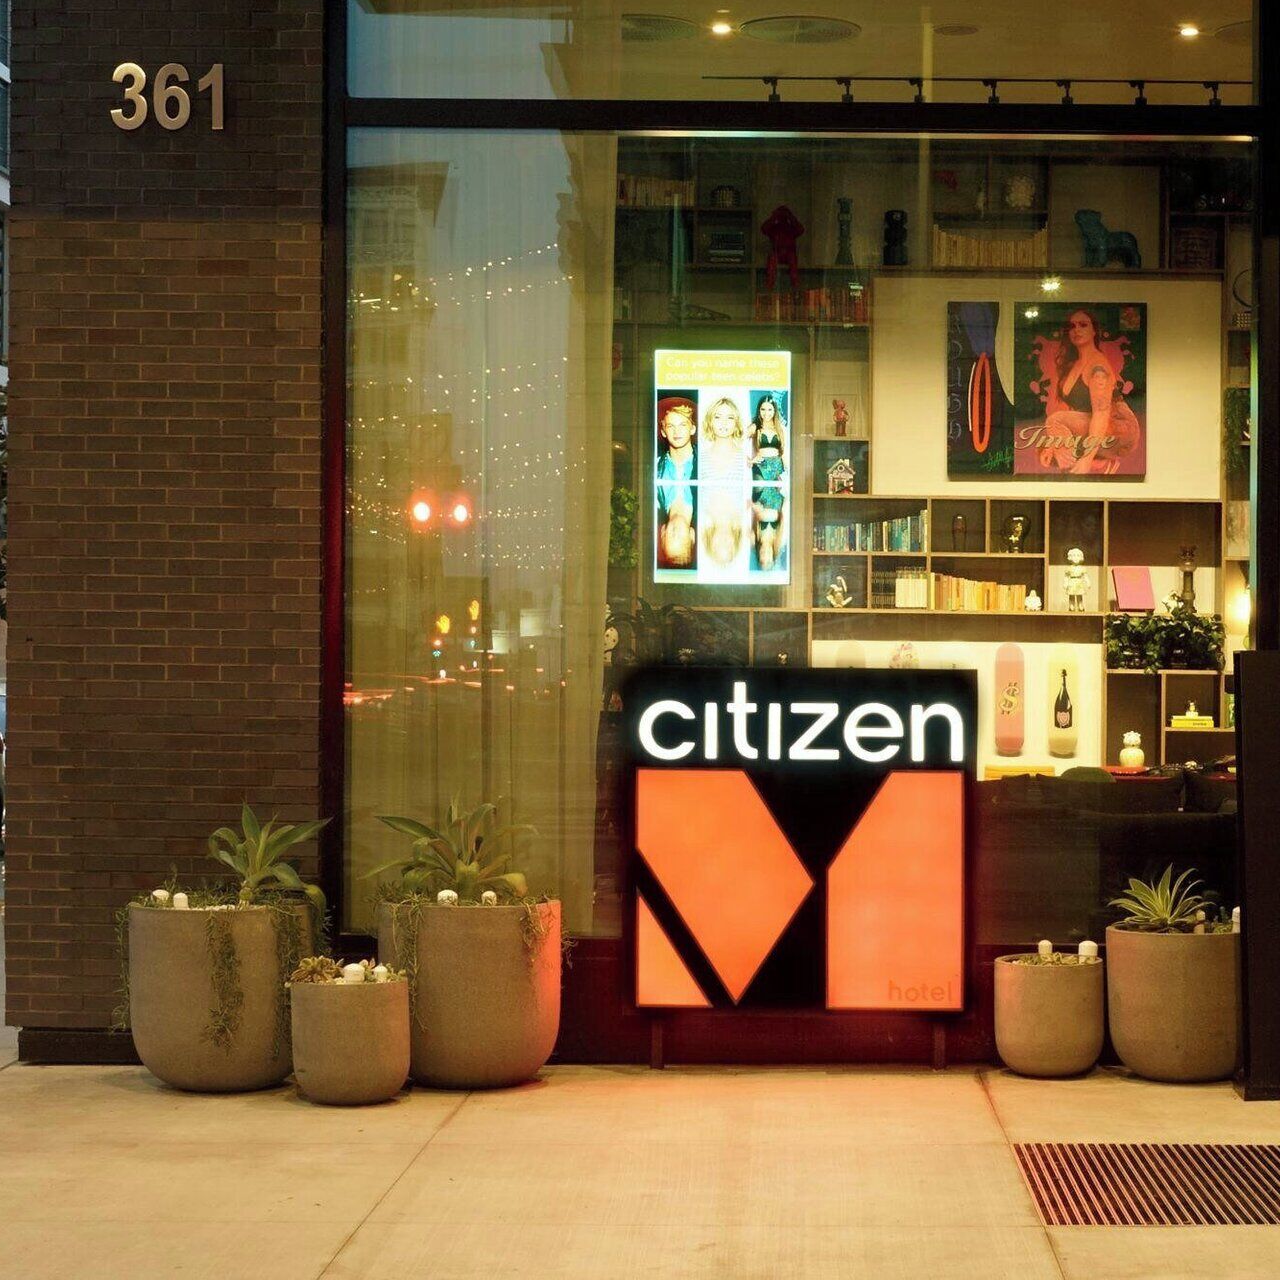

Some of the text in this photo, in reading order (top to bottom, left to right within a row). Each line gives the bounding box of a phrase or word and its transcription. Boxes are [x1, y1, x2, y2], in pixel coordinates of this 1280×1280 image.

[110, 62, 224, 131] 361
[1015, 425, 1116, 459] Image
[638, 681, 964, 762] citizen
[888, 979, 952, 1001] hotel
